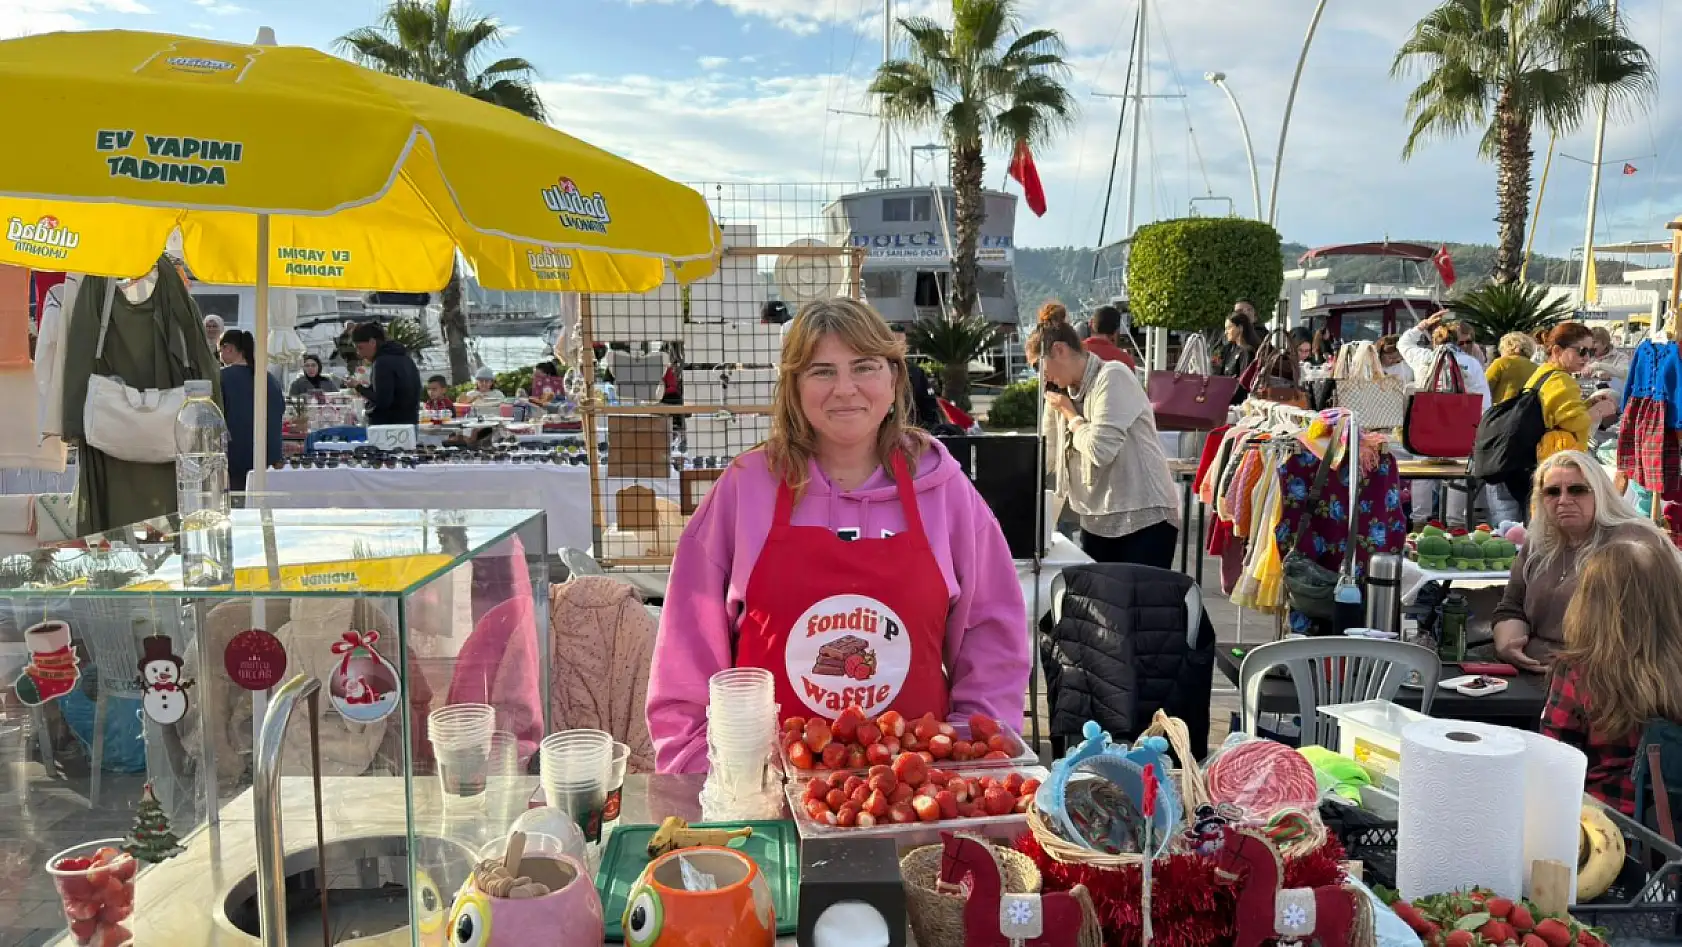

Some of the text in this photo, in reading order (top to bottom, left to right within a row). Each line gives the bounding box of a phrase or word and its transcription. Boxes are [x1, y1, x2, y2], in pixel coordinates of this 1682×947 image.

[97, 131, 242, 161] EV YAPIMI
[107, 156, 226, 184] TADINDA
[801, 675, 891, 712] waffle
